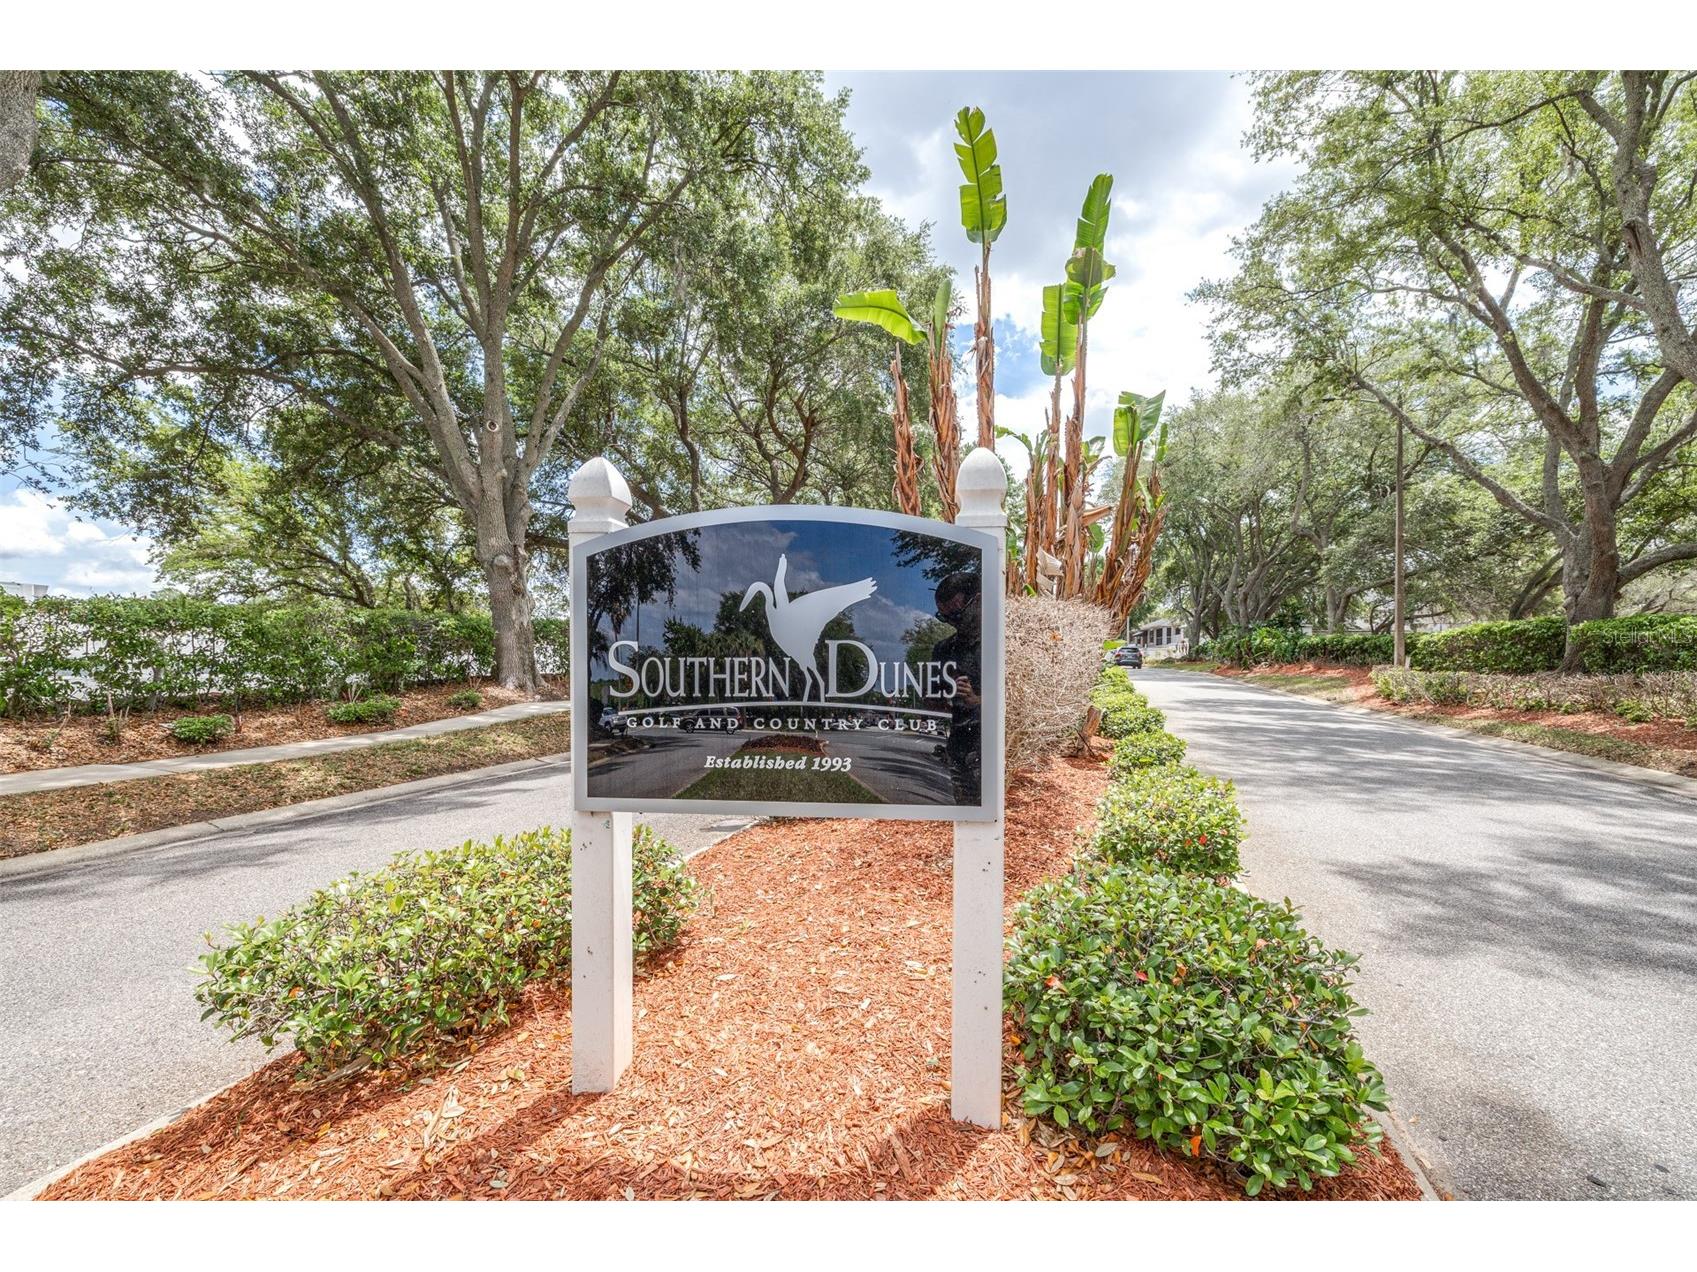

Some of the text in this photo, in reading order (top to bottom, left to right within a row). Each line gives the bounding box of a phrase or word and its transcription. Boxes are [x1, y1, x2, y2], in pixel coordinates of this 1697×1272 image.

[608, 640, 957, 698] SOUTHERN DUNES
[627, 717, 938, 731] GOLF AND COUNTRY CLUB
[704, 756, 852, 772] Established 1993
